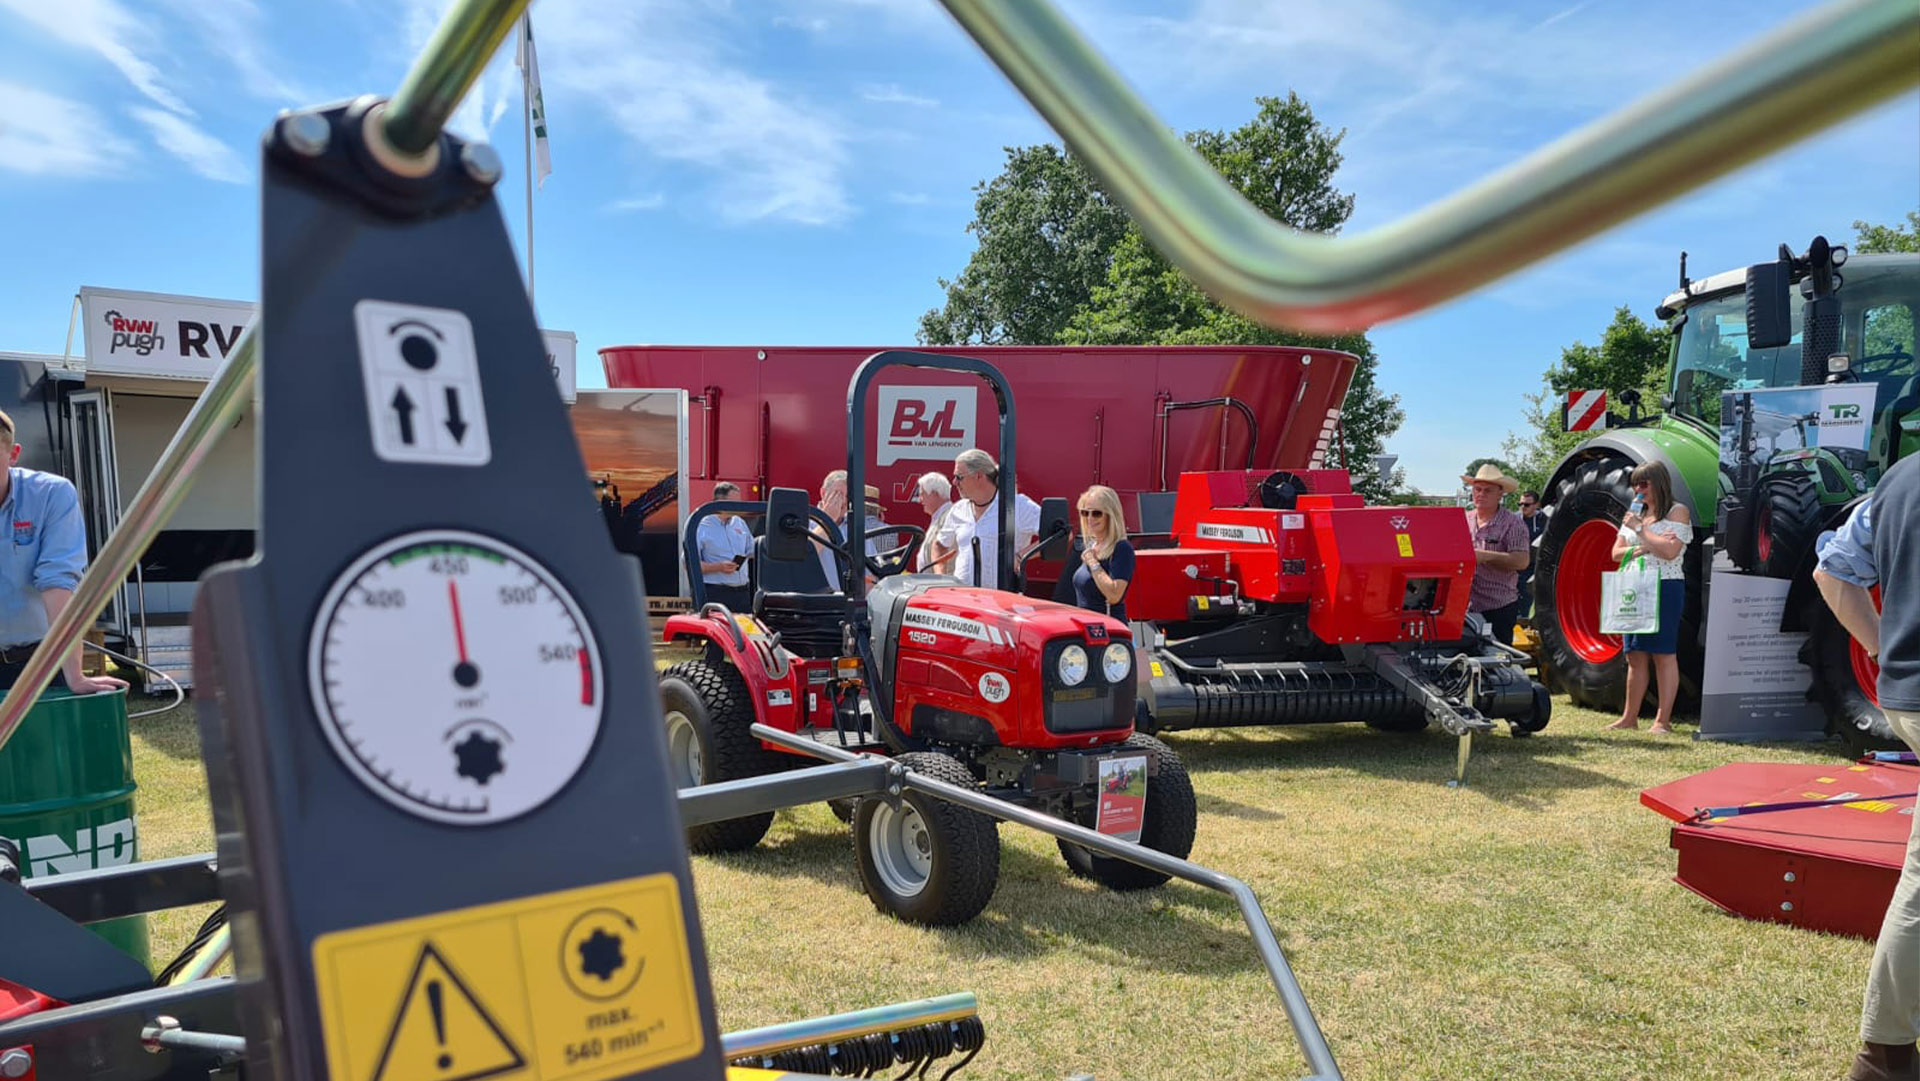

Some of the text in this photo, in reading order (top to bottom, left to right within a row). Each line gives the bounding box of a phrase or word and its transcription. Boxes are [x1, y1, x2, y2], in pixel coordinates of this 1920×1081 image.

[113, 317, 154, 334] RVW
[110, 321, 165, 356] pugh
[178, 321, 245, 359] RV
[1828, 404, 1860, 419] TR
[1201, 526, 1244, 539] MASSEY FERGUSON
[429, 558, 469, 575] 450
[364, 589, 405, 607] 400
[499, 586, 537, 605] 500
[904, 611, 981, 635] MASSEY FERGUSON
[908, 630, 937, 645] 1520
[538, 645, 576, 662] 540
[11, 815, 140, 878] ND
[586, 1006, 637, 1031] max.
[564, 1037, 603, 1066] 540
